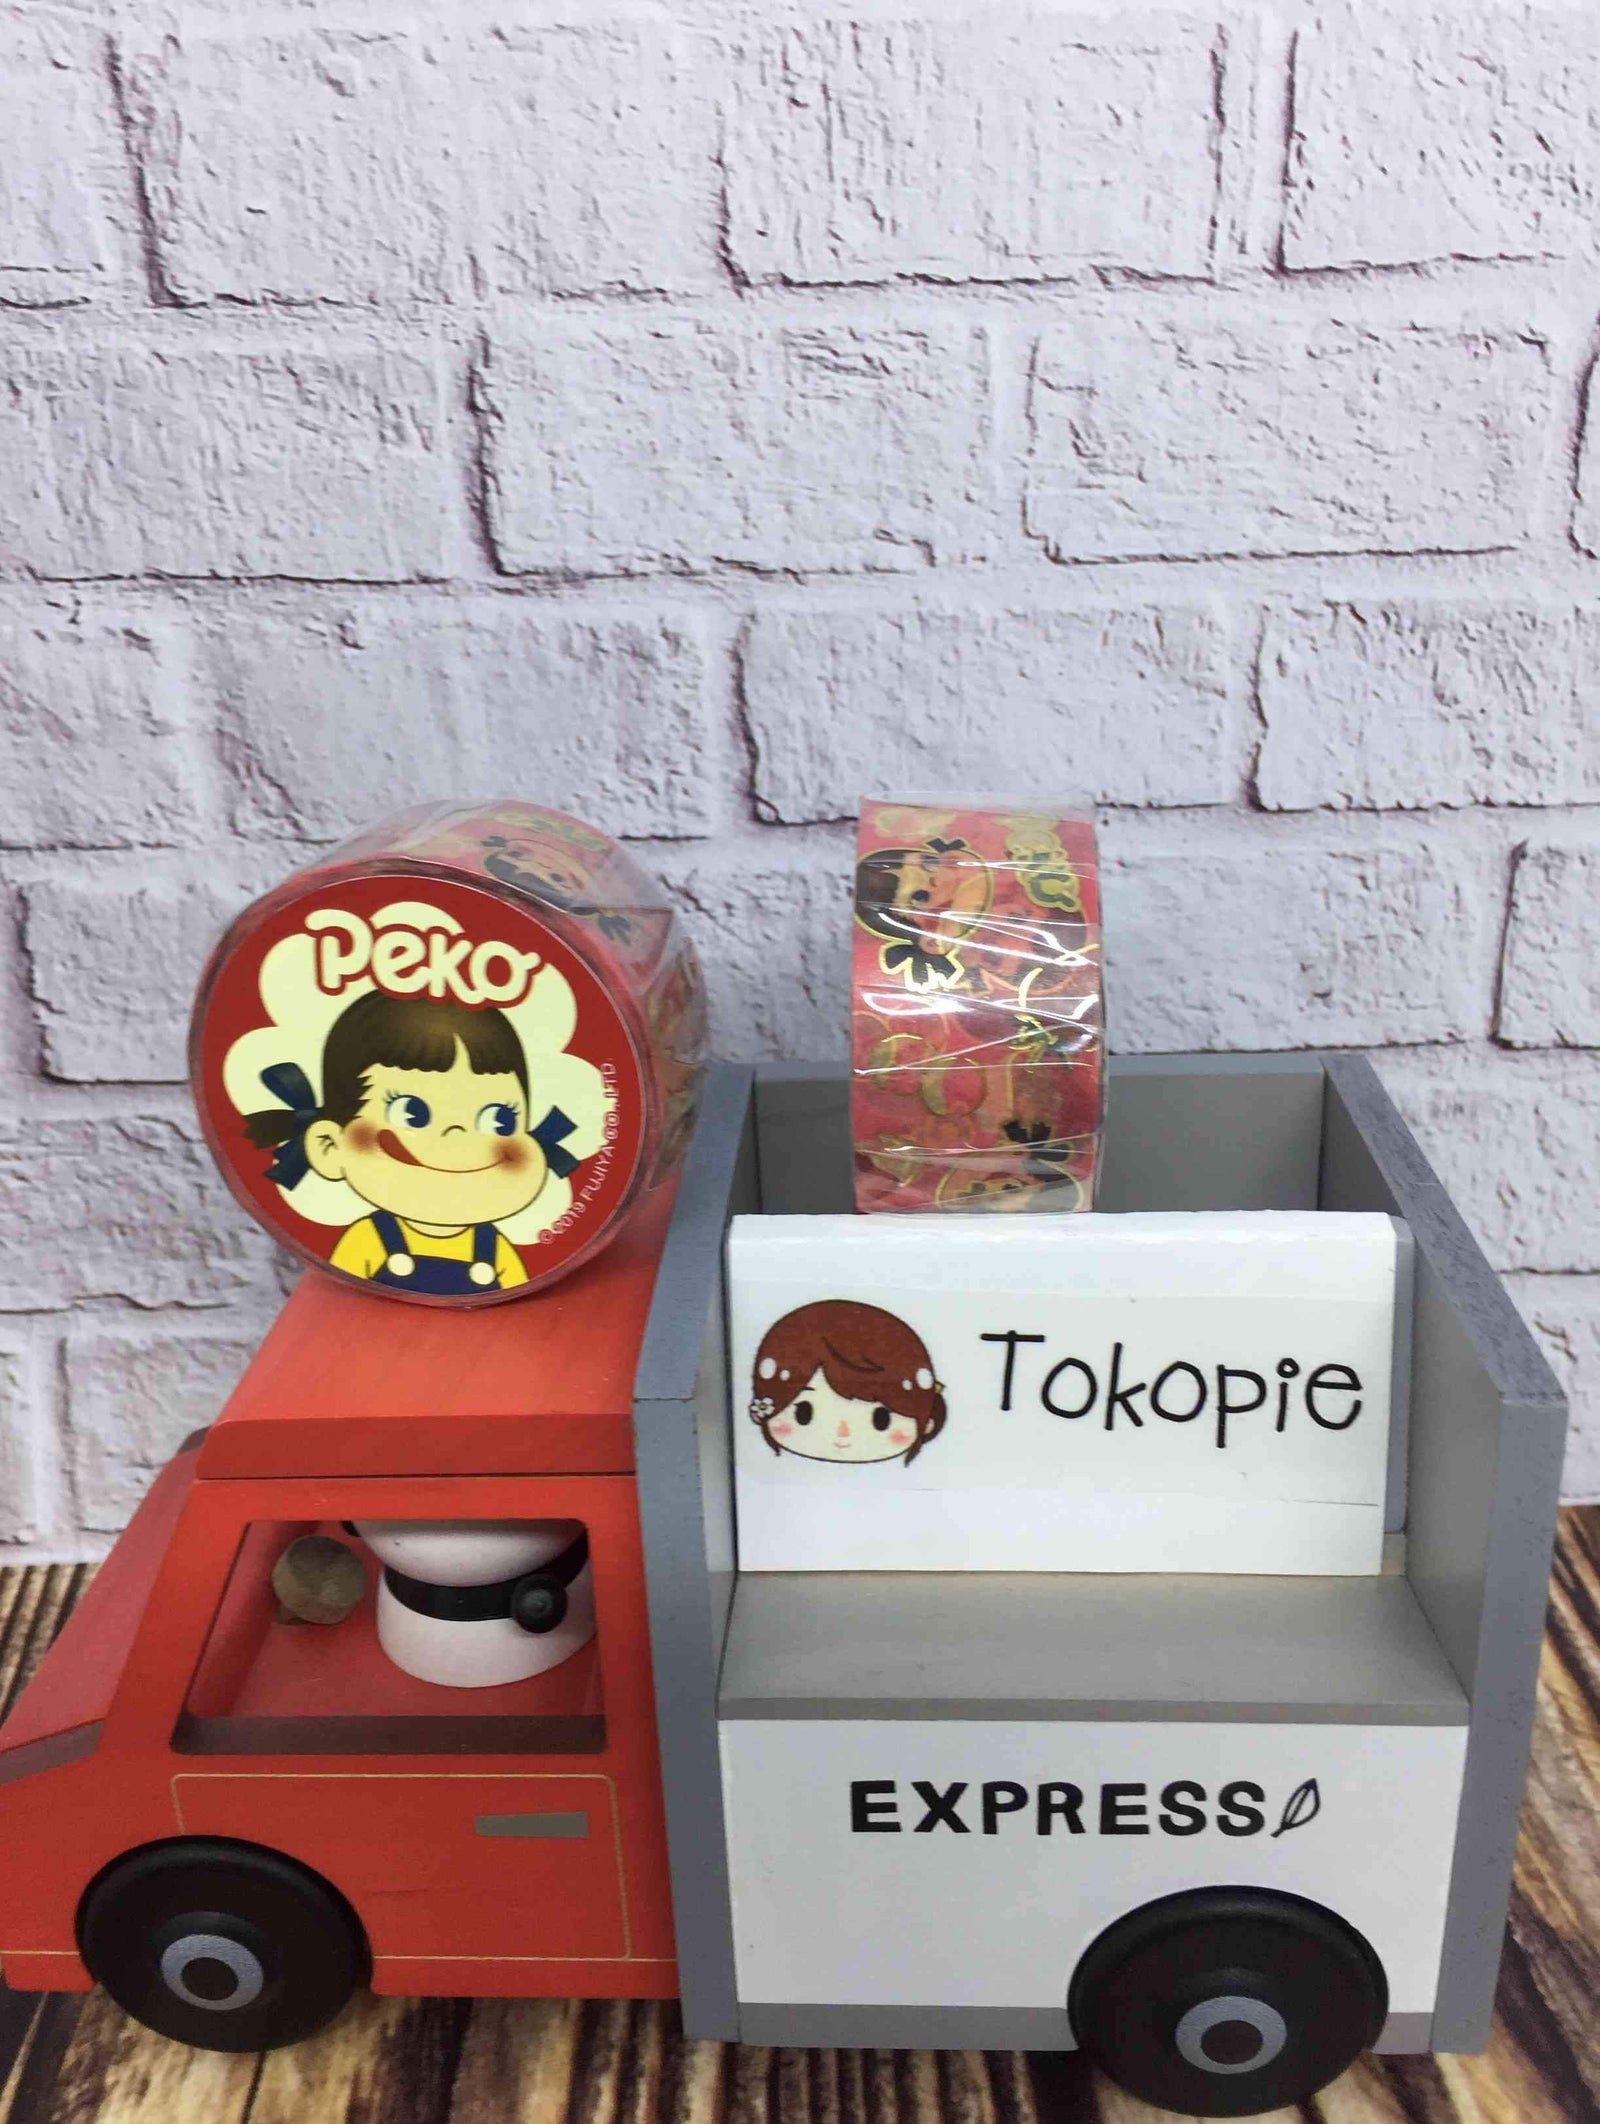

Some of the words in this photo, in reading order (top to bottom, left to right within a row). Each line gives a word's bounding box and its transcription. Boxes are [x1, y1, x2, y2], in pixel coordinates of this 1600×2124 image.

[581, 1145, 616, 1202] FUJIYA
[980, 1330, 1363, 1449] Tokopie
[850, 1779, 1266, 1837] EXPRESS
